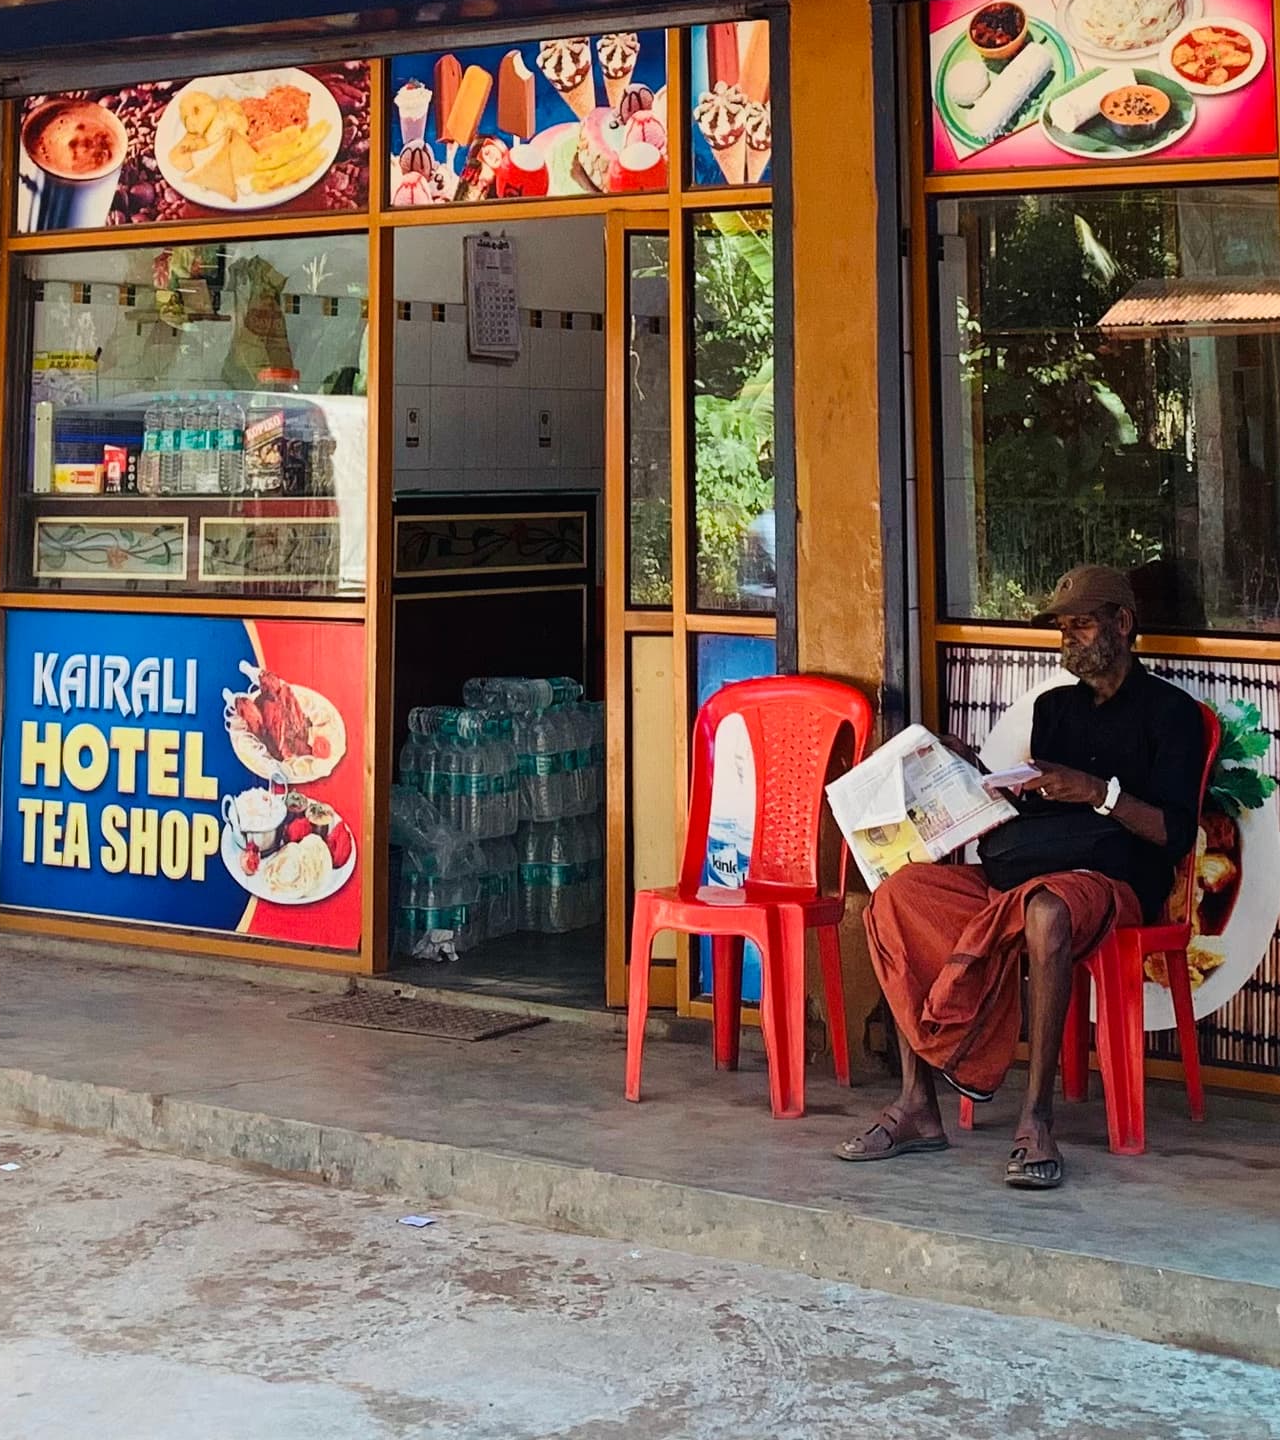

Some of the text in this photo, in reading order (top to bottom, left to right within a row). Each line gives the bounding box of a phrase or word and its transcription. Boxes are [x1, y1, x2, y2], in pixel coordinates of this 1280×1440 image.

[33, 652, 198, 718] KAIRALI
[21, 720, 219, 800] HOTEL
[18, 797, 219, 881] TEA SHOP
